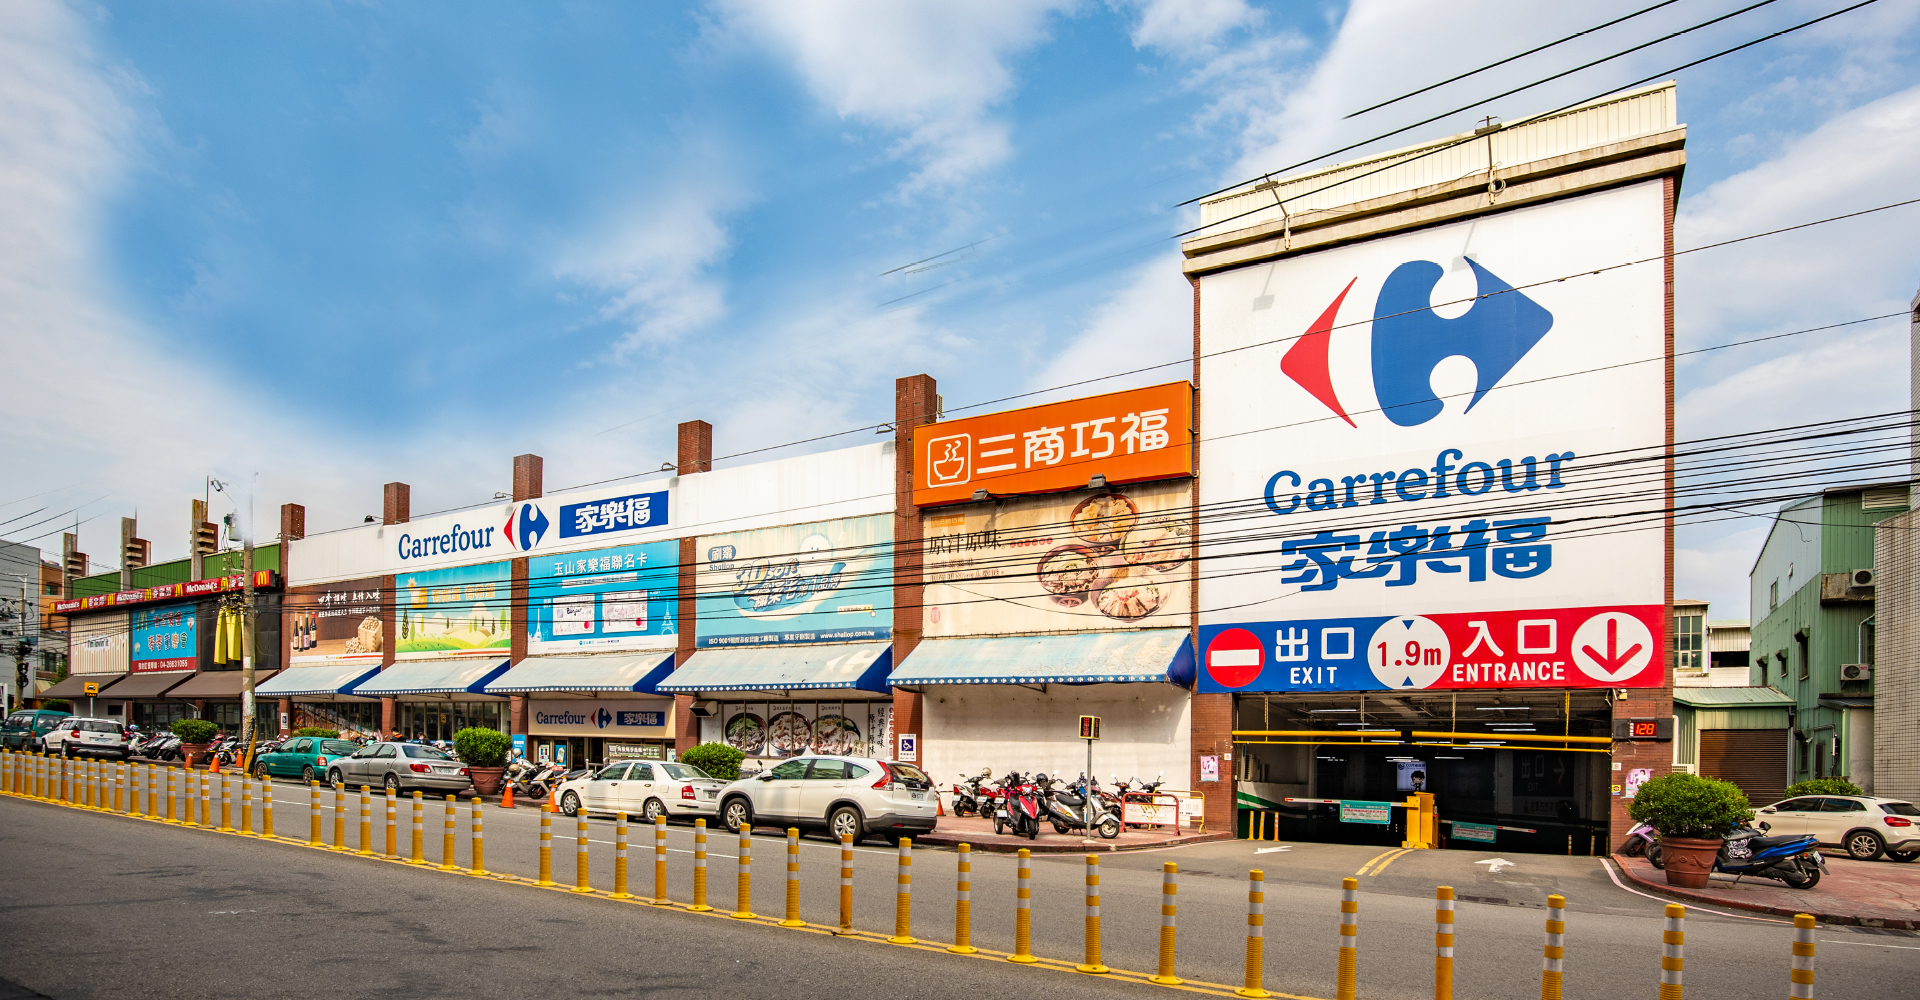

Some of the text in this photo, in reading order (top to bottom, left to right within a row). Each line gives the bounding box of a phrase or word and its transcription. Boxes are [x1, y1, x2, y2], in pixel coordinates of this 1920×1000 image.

[976, 408, 1169, 474] 三商巧福
[1264, 448, 1576, 515] Carrefour
[575, 496, 651, 533] 家樂福
[398, 523, 495, 560] Carrefour
[1280, 515, 1552, 592] 家樂福
[553, 552, 648, 576] 玉山家樂福聯名卡
[709, 562, 735, 572] Shallop
[57, 601, 79, 611] McDonald's
[117, 592, 143, 602] McDonald's
[186, 582, 218, 593] McDonald's
[431, 586, 461, 603] 有能量
[464, 582, 496, 601] 有希望
[708, 637, 718, 645] ISO
[819, 630, 876, 640] www.shallop.com.tw
[1275, 618, 1558, 663] 出口 入口
[1376, 640, 1442, 669] 1.9m
[1290, 661, 1566, 685] EXIT ENTRANCE
[536, 710, 586, 725] Carrefour
[623, 712, 658, 726] 家樂福
[1635, 723, 1655, 735] 128
